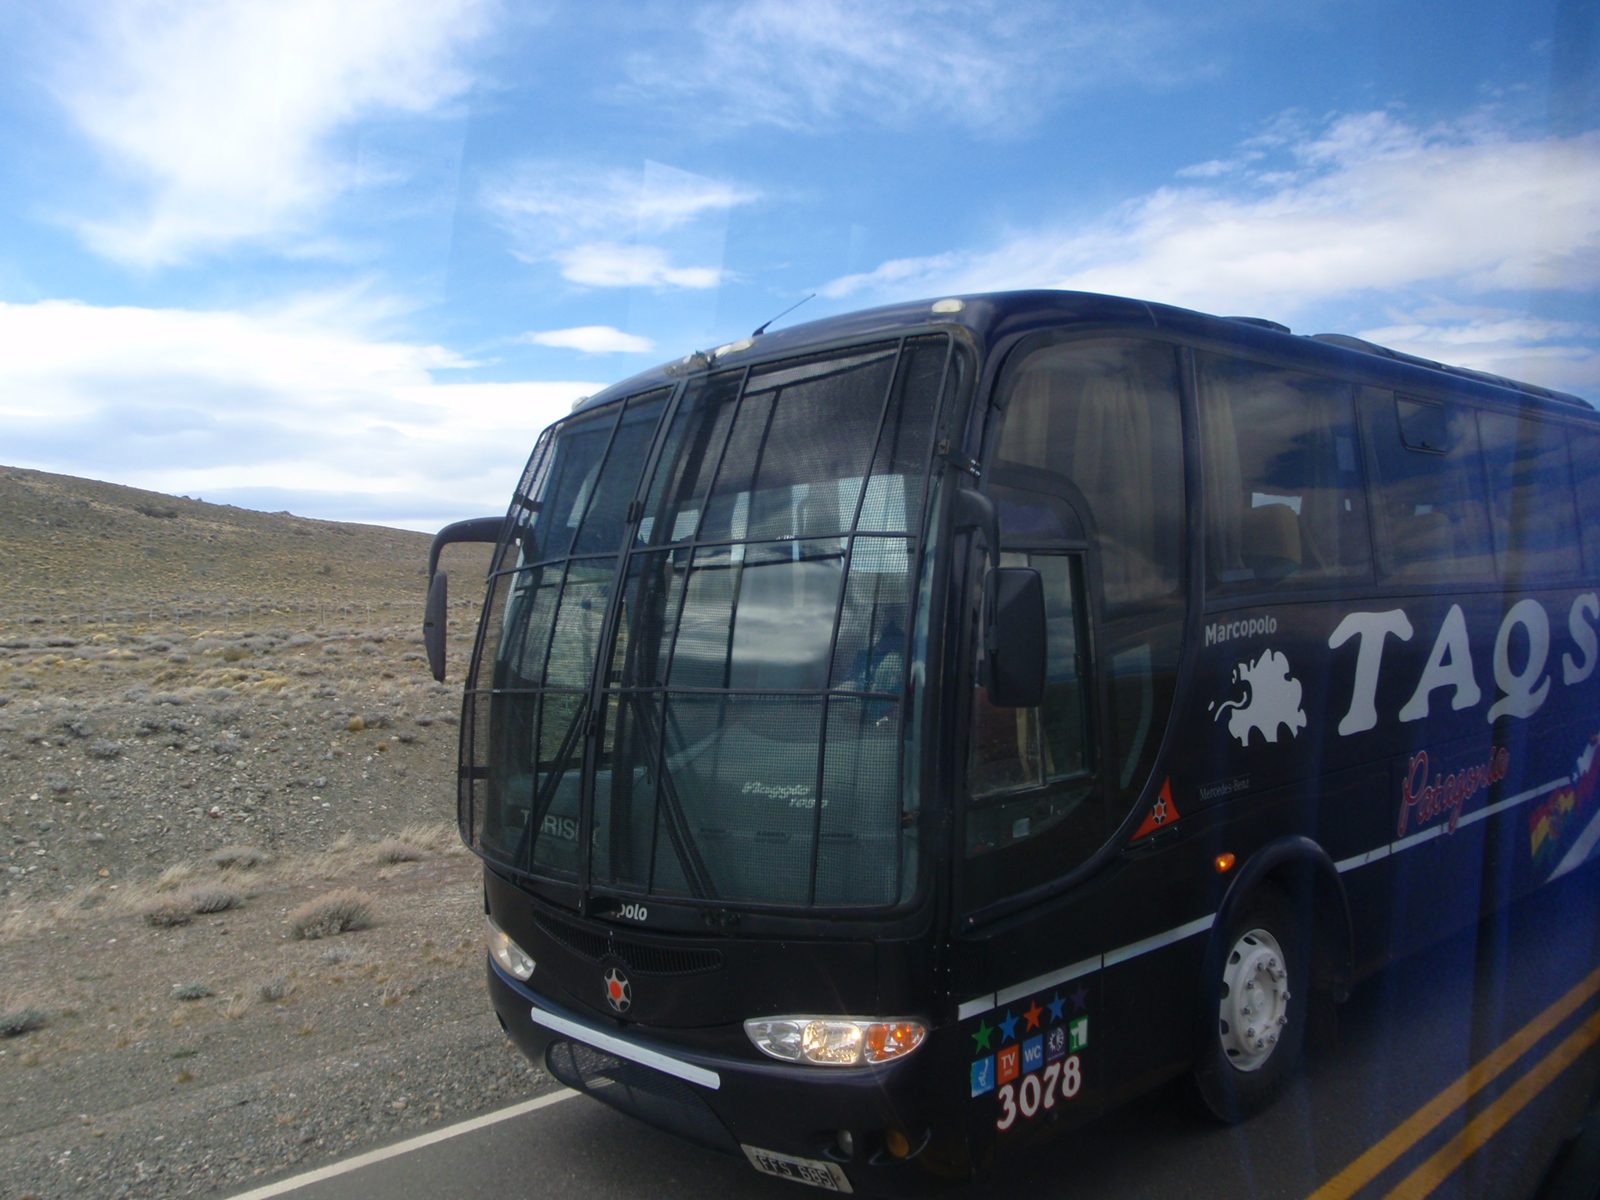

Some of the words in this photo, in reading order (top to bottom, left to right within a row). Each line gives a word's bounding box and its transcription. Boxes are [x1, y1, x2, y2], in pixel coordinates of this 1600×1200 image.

[1204, 615, 1278, 648] Marcopolo
[1001, 1052, 1016, 1069] TV
[1024, 1044, 1042, 1063] WC
[996, 1055, 1082, 1131] 3078
